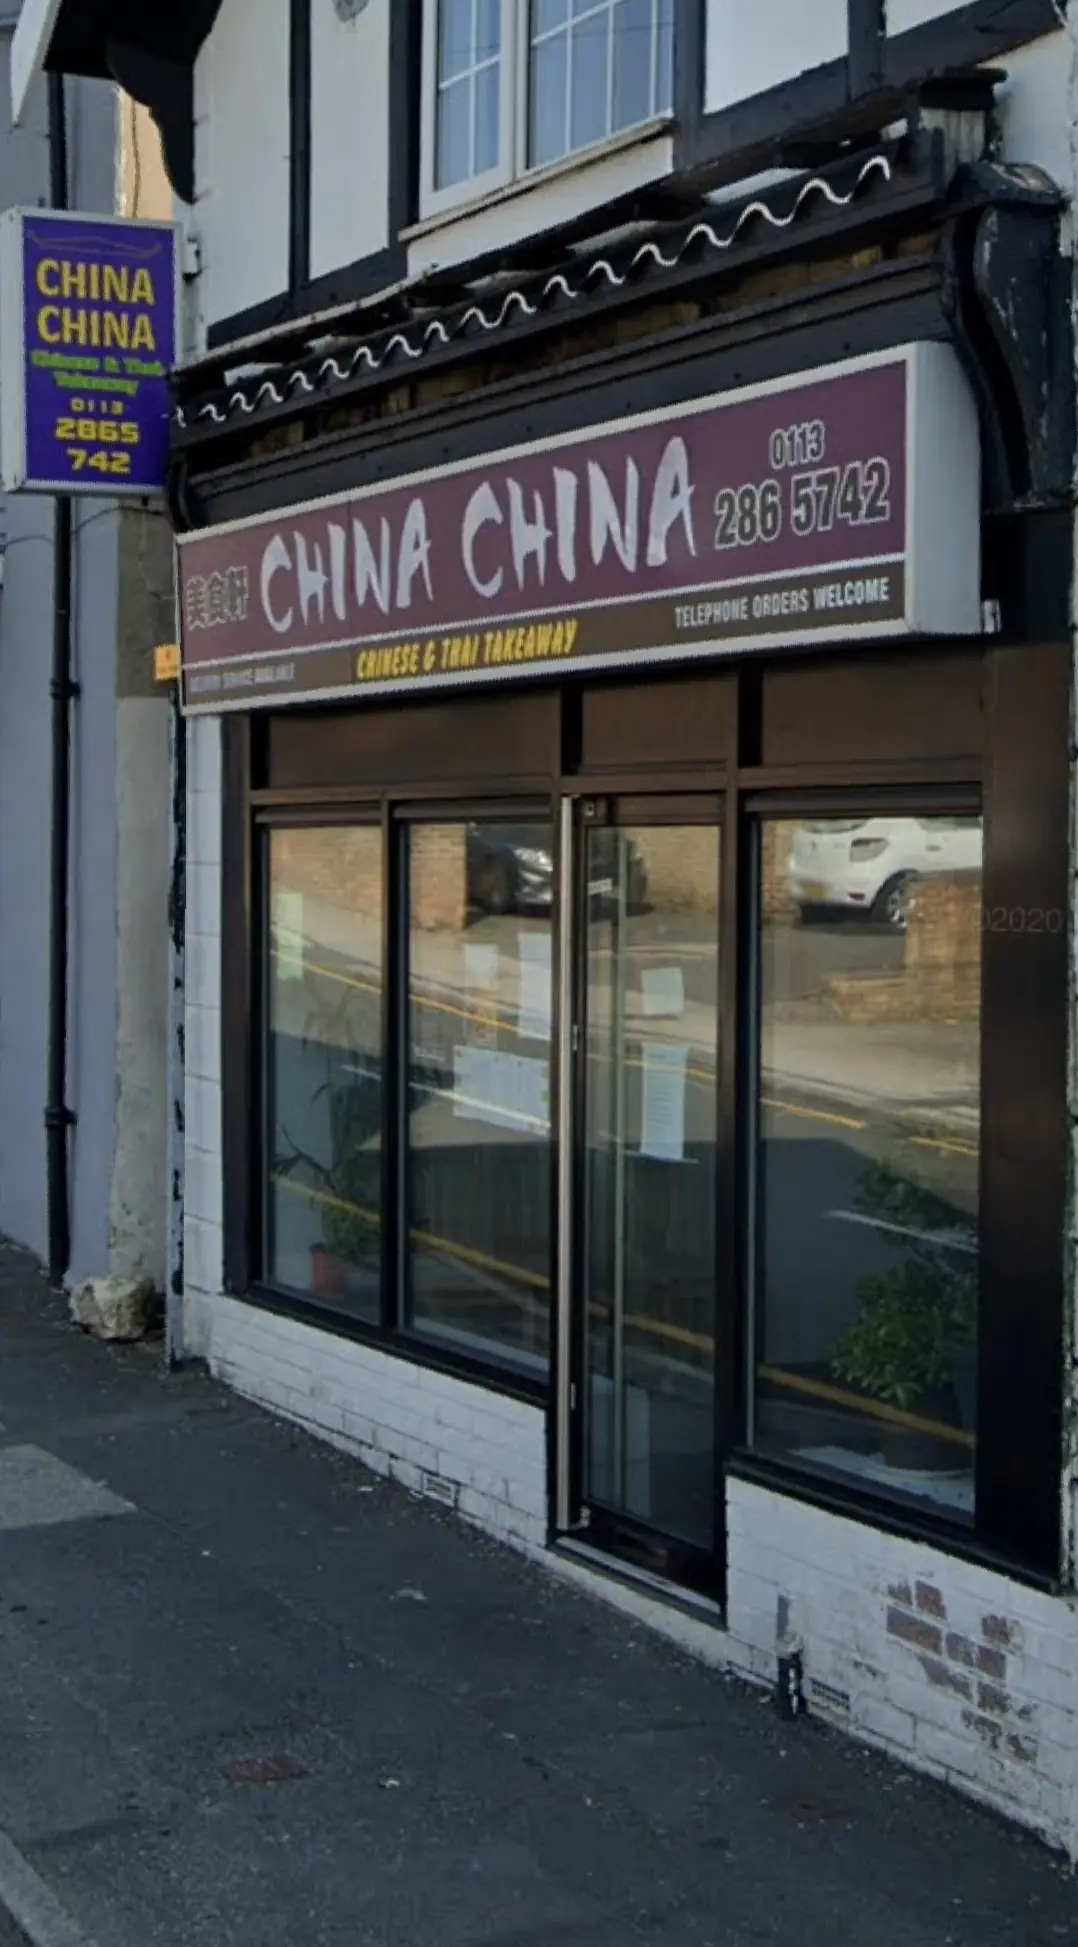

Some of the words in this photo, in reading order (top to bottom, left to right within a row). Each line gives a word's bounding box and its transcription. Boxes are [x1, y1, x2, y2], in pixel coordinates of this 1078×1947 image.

[37, 259, 154, 305] CHINA
[37, 306, 155, 351] CHINA
[70, 397, 124, 414] 0113
[56, 418, 139, 443] 2865
[769, 419, 825, 470] 0113
[67, 449, 130, 474] 742
[714, 479, 783, 551] 286
[790, 456, 891, 536] 5742
[261, 498, 433, 632] CHINA
[462, 436, 696, 600] CHINA
[675, 602, 748, 629] TELEPHONE
[752, 587, 809, 618] ORDERS
[813, 575, 891, 609] WELCOME
[357, 644, 420, 680] CHINESE
[441, 633, 479, 668] THAI
[484, 617, 579, 662] TAKEAWAY
